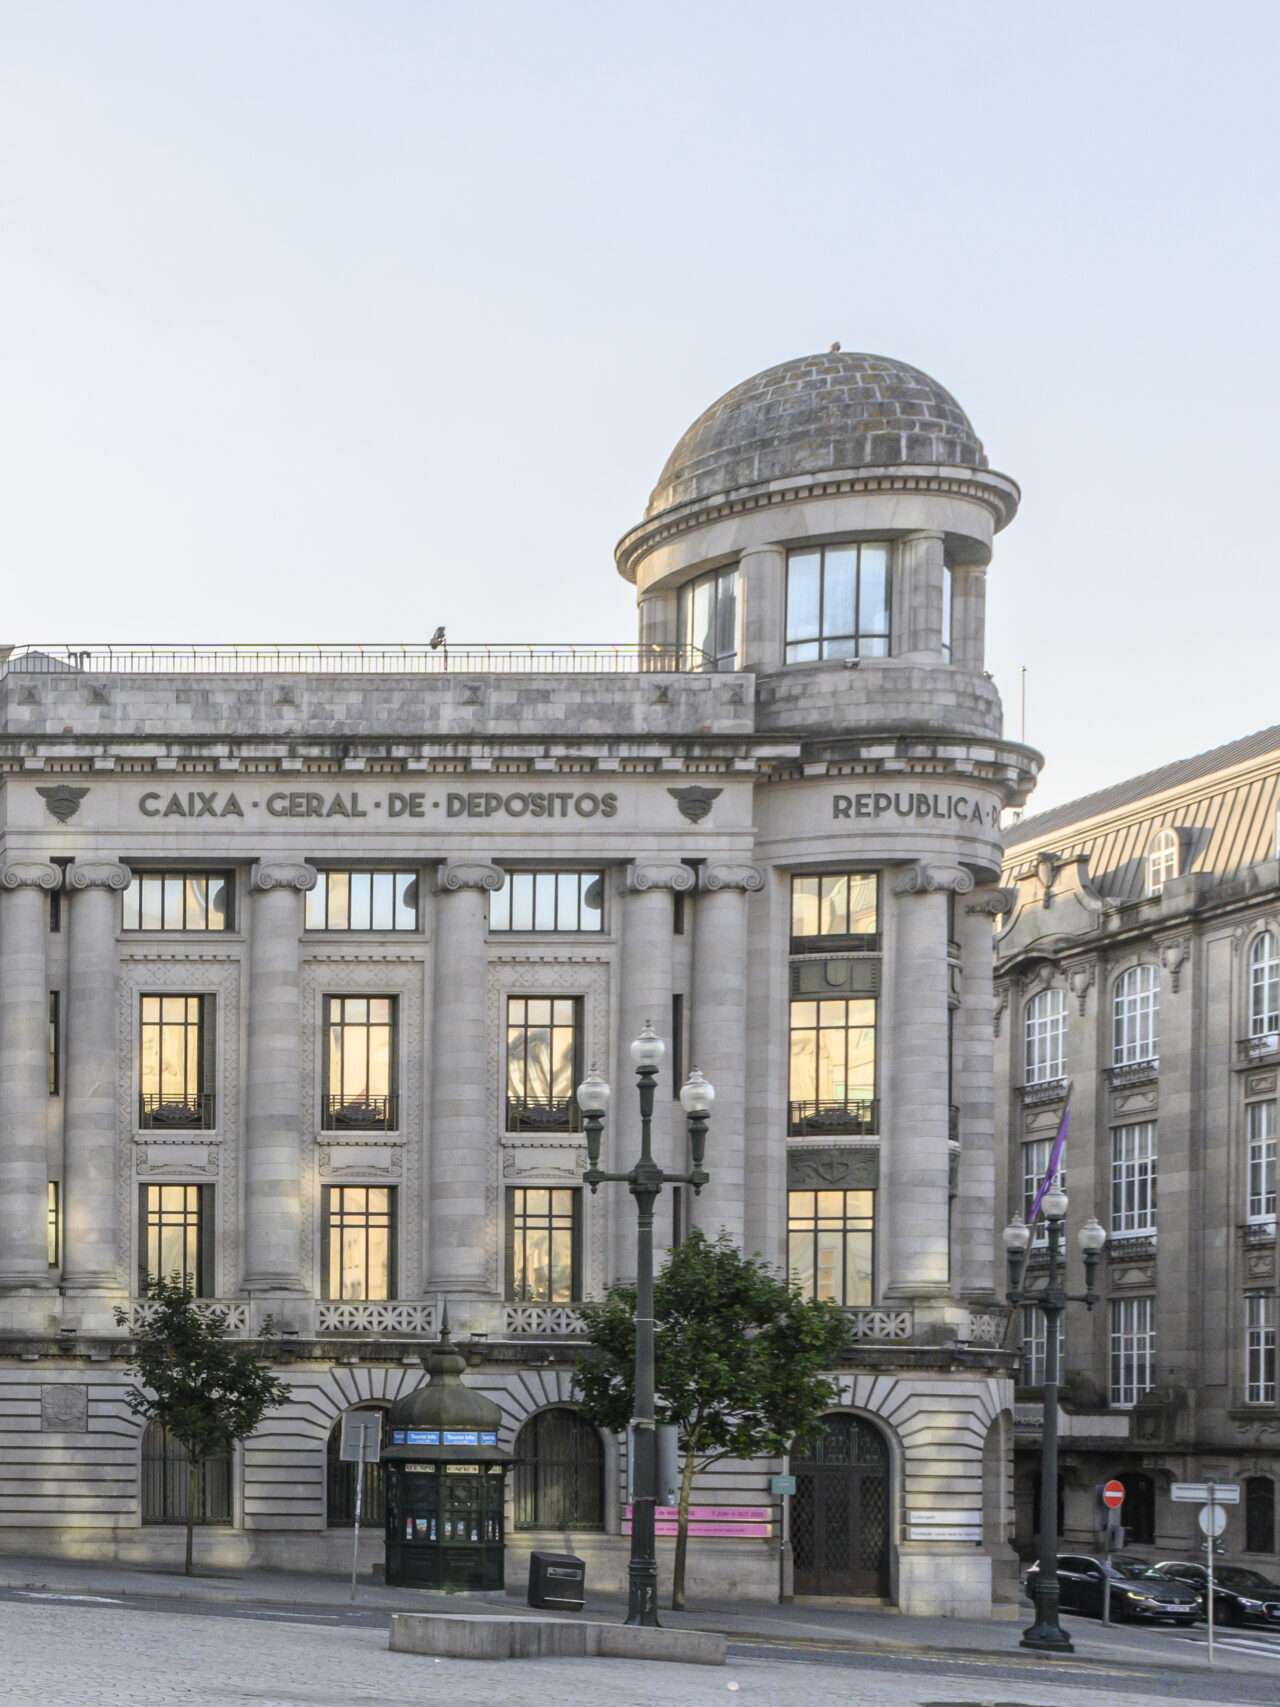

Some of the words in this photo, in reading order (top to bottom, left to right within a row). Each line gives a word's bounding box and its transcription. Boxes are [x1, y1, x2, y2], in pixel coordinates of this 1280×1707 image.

[138, 791, 245, 818] CAIXA
[266, 791, 368, 818] GERAL
[388, 792, 426, 818] DE
[446, 791, 619, 818] DEPÓSITOS
[832, 793, 983, 825] REPUBLICA
